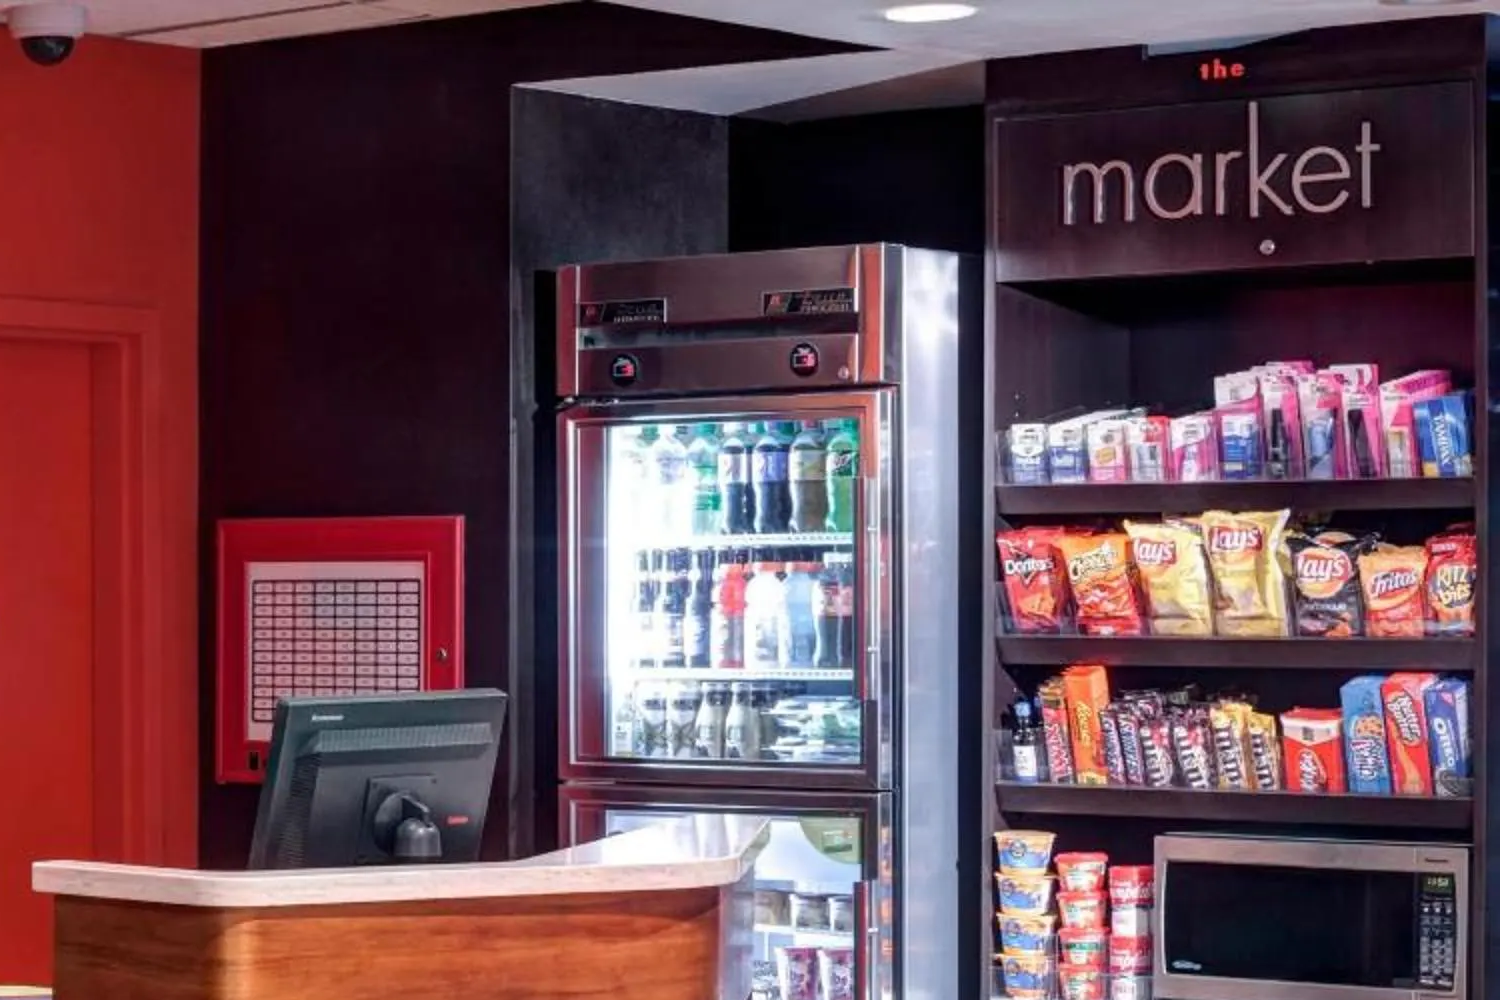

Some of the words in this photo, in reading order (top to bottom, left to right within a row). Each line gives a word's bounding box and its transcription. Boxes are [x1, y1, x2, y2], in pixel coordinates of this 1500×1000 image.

[1199, 58, 1246, 80] the
[1062, 101, 1382, 226] market
[1004, 558, 1055, 576] Doritos
[1371, 567, 1418, 598] Fritos
